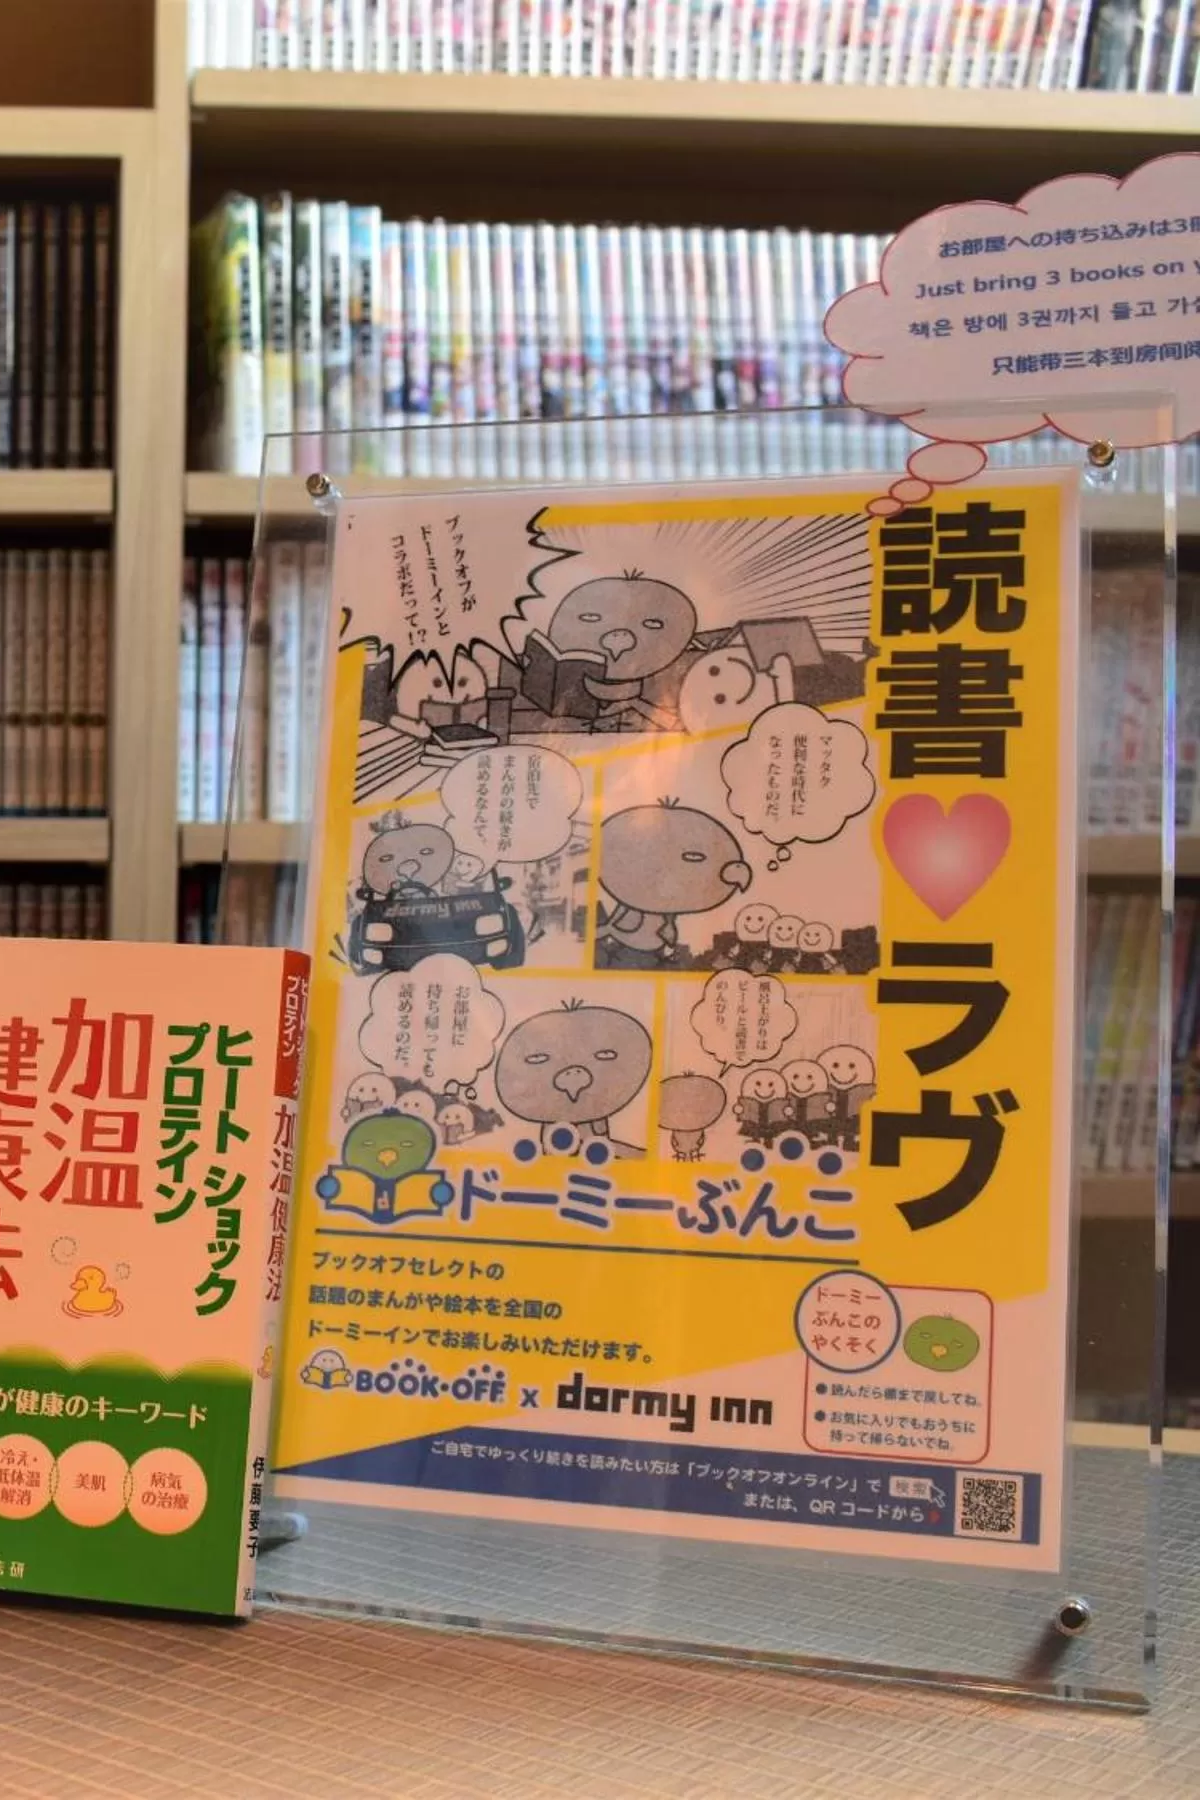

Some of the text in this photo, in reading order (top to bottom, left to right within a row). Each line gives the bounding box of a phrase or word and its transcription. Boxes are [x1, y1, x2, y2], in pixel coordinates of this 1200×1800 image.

[915, 281, 964, 299] Just
[973, 274, 1037, 292] bring
[1046, 270, 1060, 285] 3
[1070, 263, 1144, 283] books
[1152, 261, 1184, 275] on
[908, 318, 954, 339] 책은
[963, 313, 1008, 334] 방에
[1018, 304, 1099, 328] 3권까지
[1111, 300, 1156, 321] 들고
[420, 524, 451, 637] ドーミーインと
[870, 502, 1026, 1232] 読書 ラヴ
[282, 975, 300, 1057] プロテイン
[39, 997, 154, 1209] 加温
[154, 1022, 211, 1225] プロテイン
[194, 1024, 254, 1317] ヒートショック
[458, 1167, 857, 1241] ドーミーぶんこ
[312, 1250, 505, 1281] ブックオフセレクトの
[309, 1284, 563, 1320] 話題のまんがや絵本を全国の
[816, 1286, 881, 1305] ドーミー
[812, 1311, 881, 1330] ぶんこの
[308, 1319, 653, 1365] ドーミーインでお楽しみいただけます。
[812, 1334, 878, 1355] やくそく
[556, 1372, 696, 1433] dormy
[710, 1395, 773, 1425] inn
[830, 1411, 976, 1434] お気に入りでもおうちに
[75, 1472, 106, 1491] 美肌
[150, 1472, 183, 1491] 病気
